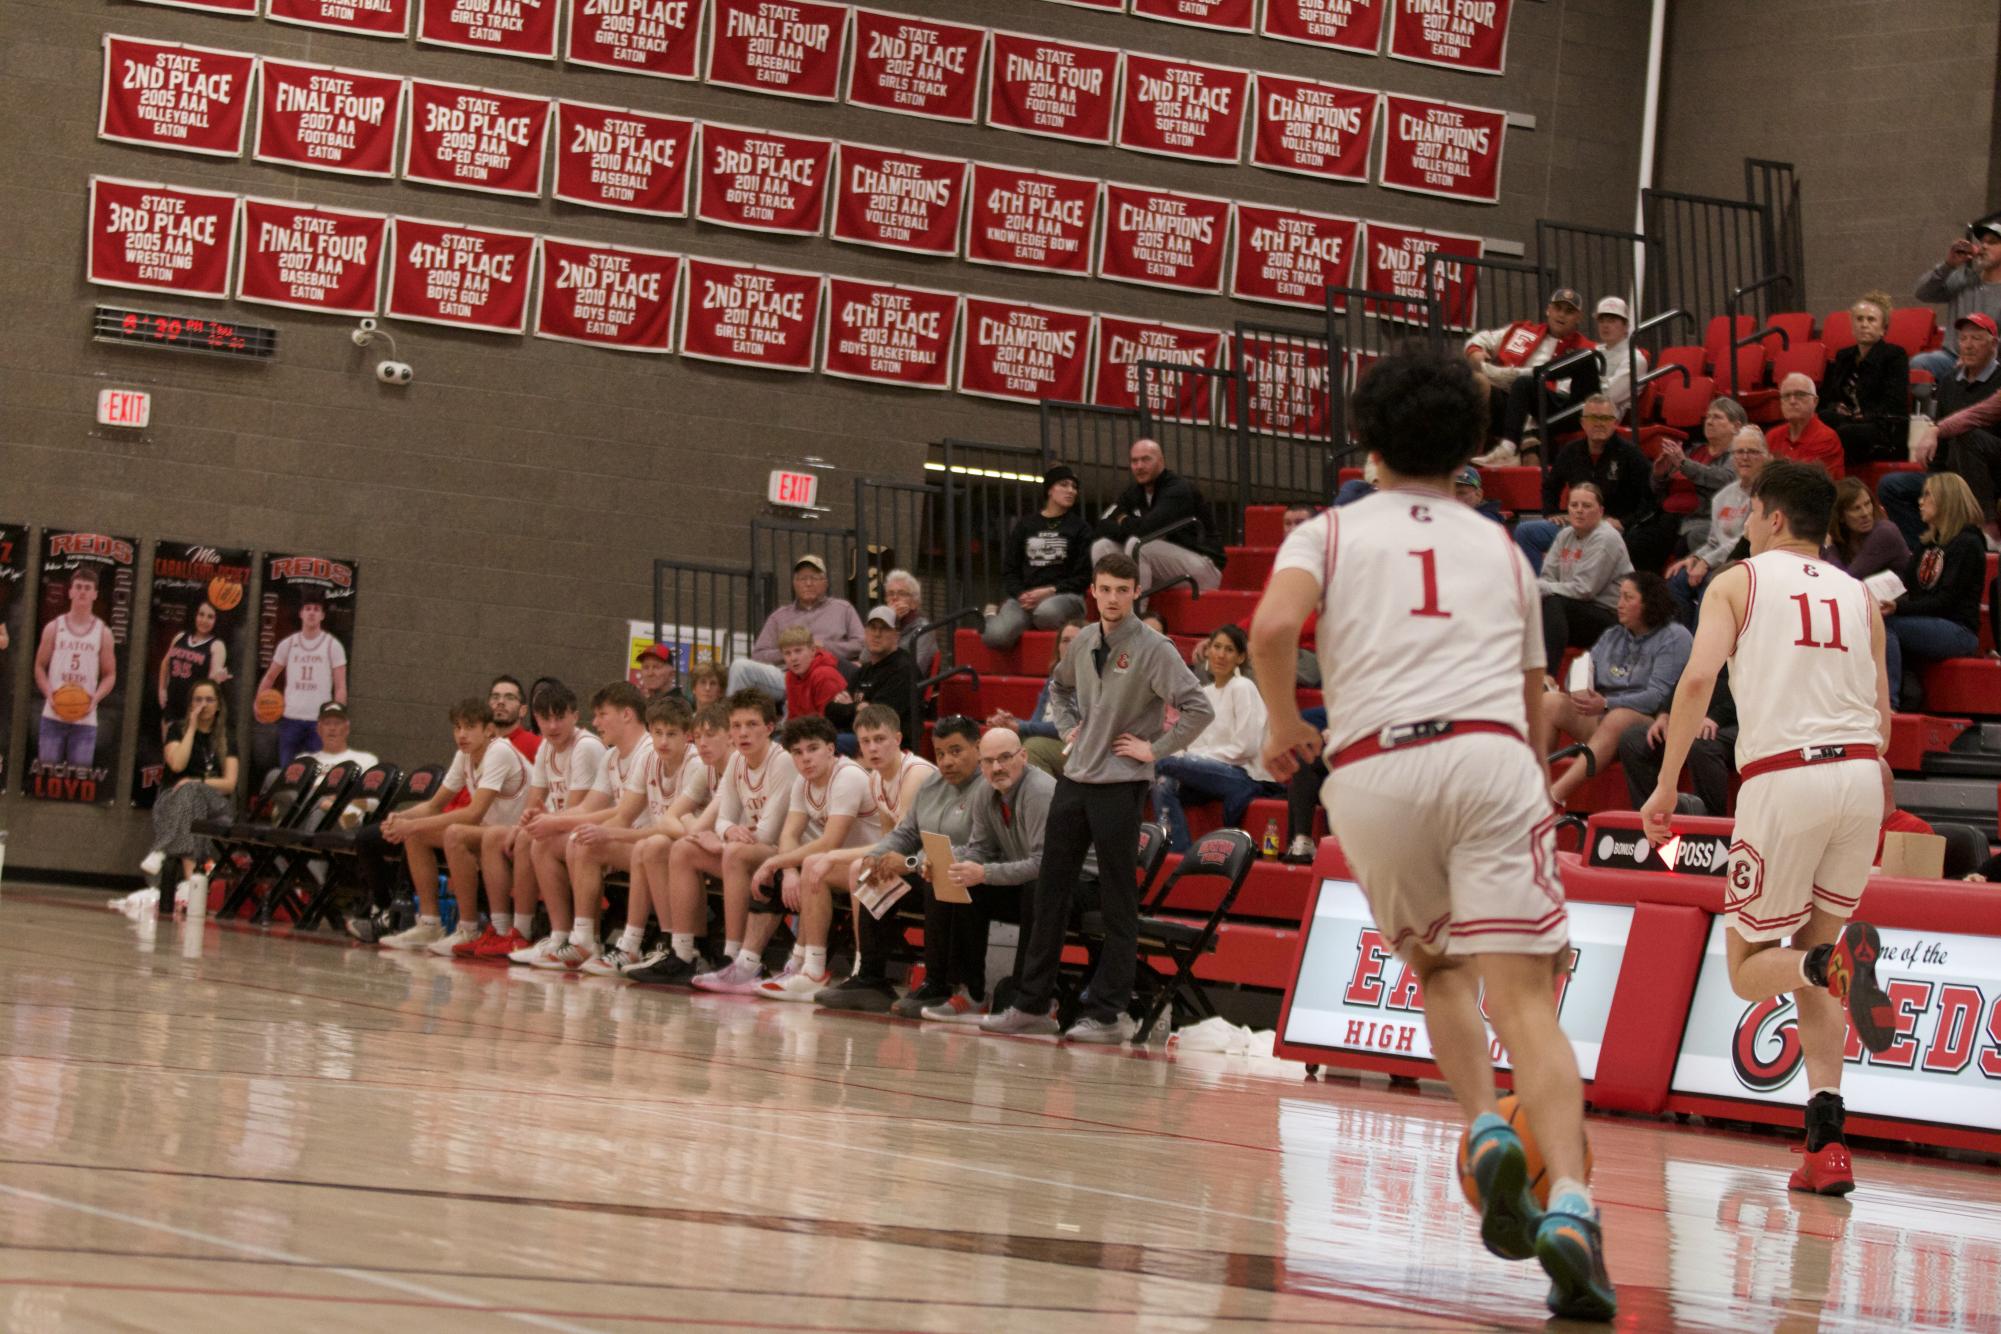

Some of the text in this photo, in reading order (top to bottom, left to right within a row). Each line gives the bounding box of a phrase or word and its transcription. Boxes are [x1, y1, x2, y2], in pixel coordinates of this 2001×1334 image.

[450, 8, 524, 31] GIRLS TRACK
[583, 0, 688, 28] 2ND PLACE
[758, 2, 800, 21] STATE
[1405, 0, 1496, 29] FINAL FOUR
[468, 25, 502, 42] EATON
[638, 18, 666, 39] AAA
[726, 8, 830, 51] FINAL FOUR
[898, 25, 939, 45] STATE
[1421, 13, 1475, 36] 2017 AAA
[594, 29, 668, 52] GIRLS TRACK
[747, 37, 804, 60] 2011 AAA
[1423, 28, 1471, 48] SOFTBALL
[613, 46, 646, 63] EATON
[867, 30, 967, 73] 2ND PLACE
[1431, 42, 1460, 58] EATON
[155, 52, 200, 72] STATE
[746, 52, 801, 73] BASEBALL
[885, 58, 943, 81] 2012 AAA
[122, 59, 232, 103] 2ND PLACE
[309, 75, 353, 95] STATE
[756, 68, 789, 84] EATON
[878, 73, 948, 97] GIRLS TRACK
[178, 91, 208, 113] AAA
[275, 82, 385, 125] FINAL FOUR
[456, 95, 500, 115] STATE
[894, 90, 926, 106] EATON
[1296, 88, 1334, 107] STATE
[137, 104, 208, 128] VOLLEYBALL
[299, 112, 356, 135] 2007 AA
[1267, 93, 1361, 133] CHAMPIONS
[153, 121, 188, 138] EATON
[425, 102, 530, 146] 3RD PLACE
[1314, 124, 1339, 143] AAA
[297, 128, 355, 149] FOOTBALL
[479, 135, 507, 155] AAA
[1281, 136, 1340, 157] VOLLEYBALL
[307, 144, 342, 160] EATON
[436, 146, 511, 169] CO-ED SPIRIT
[1294, 151, 1324, 166] EATON
[454, 163, 488, 180] EATON
[1017, 179, 1056, 198] STATE
[140, 194, 185, 214] STATE
[987, 188, 1084, 227] 4TH PLACE
[106, 202, 217, 245] 3RD PLACE
[292, 215, 336, 235] STATE
[1004, 214, 1062, 236] 2014 AAA
[1278, 217, 1316, 236] STATE
[163, 235, 194, 256] AAA
[258, 222, 367, 265] FINAL FOUR
[441, 233, 484, 253] STATE
[986, 227, 1047, 248] KNOWLEDGE
[1250, 226, 1342, 264] 4TH PLACE
[1403, 237, 1440, 253] STATE
[125, 248, 192, 269] WRESTLING
[408, 241, 514, 282] 4TH PLACE
[1015, 245, 1045, 260] EATON
[1376, 242, 1411, 270] 2ND
[138, 264, 173, 281] EATON
[278, 252, 343, 275] 2007 AAA
[1296, 254, 1321, 273] AAA
[279, 268, 338, 289] BASEBALL
[462, 272, 490, 292] AAA
[733, 273, 775, 292] STATE
[1262, 265, 1324, 286] BOYS TRACK
[1393, 270, 1418, 286] 2017
[290, 284, 325, 300] EATON
[426, 284, 488, 305] BOYS GOLF
[1276, 281, 1305, 296] EATON
[438, 300, 472, 317] EATON
[702, 280, 804, 321] 2ND PLACE
[723, 307, 779, 329] 2011 AAA
[1008, 311, 1048, 330] STATE
[714, 323, 786, 345] GIRLS TRACK
[978, 317, 1076, 358] CHAMPIONS
[1139, 330, 1177, 349] STATE
[732, 339, 764, 355] EATON
[996, 345, 1054, 368] 2014 AAA
[992, 360, 1055, 382] VOLLEYBALL
[1006, 376, 1037, 392] EATON
[108, 392, 145, 424] EXIT
[778, 472, 813, 505] EXIT
[49, 532, 134, 566] REDS
[185, 544, 223, 565] Mia
[271, 556, 353, 588] REDS
[1408, 548, 1453, 619] 1
[1790, 592, 1849, 653] 11
[59, 639, 96, 653] EATON
[70, 653, 82, 672] 5
[293, 655, 323, 664] EATON
[300, 666, 314, 681] 11
[30, 759, 109, 783] Andrew
[34, 774, 97, 801] LOYD
[1613, 842, 1636, 857] BONUS
[1676, 841, 1714, 869] POSS
[1899, 939, 1923, 971] of
[1922, 941, 1949, 966] the
[1343, 1019, 1417, 1053] HIGH
